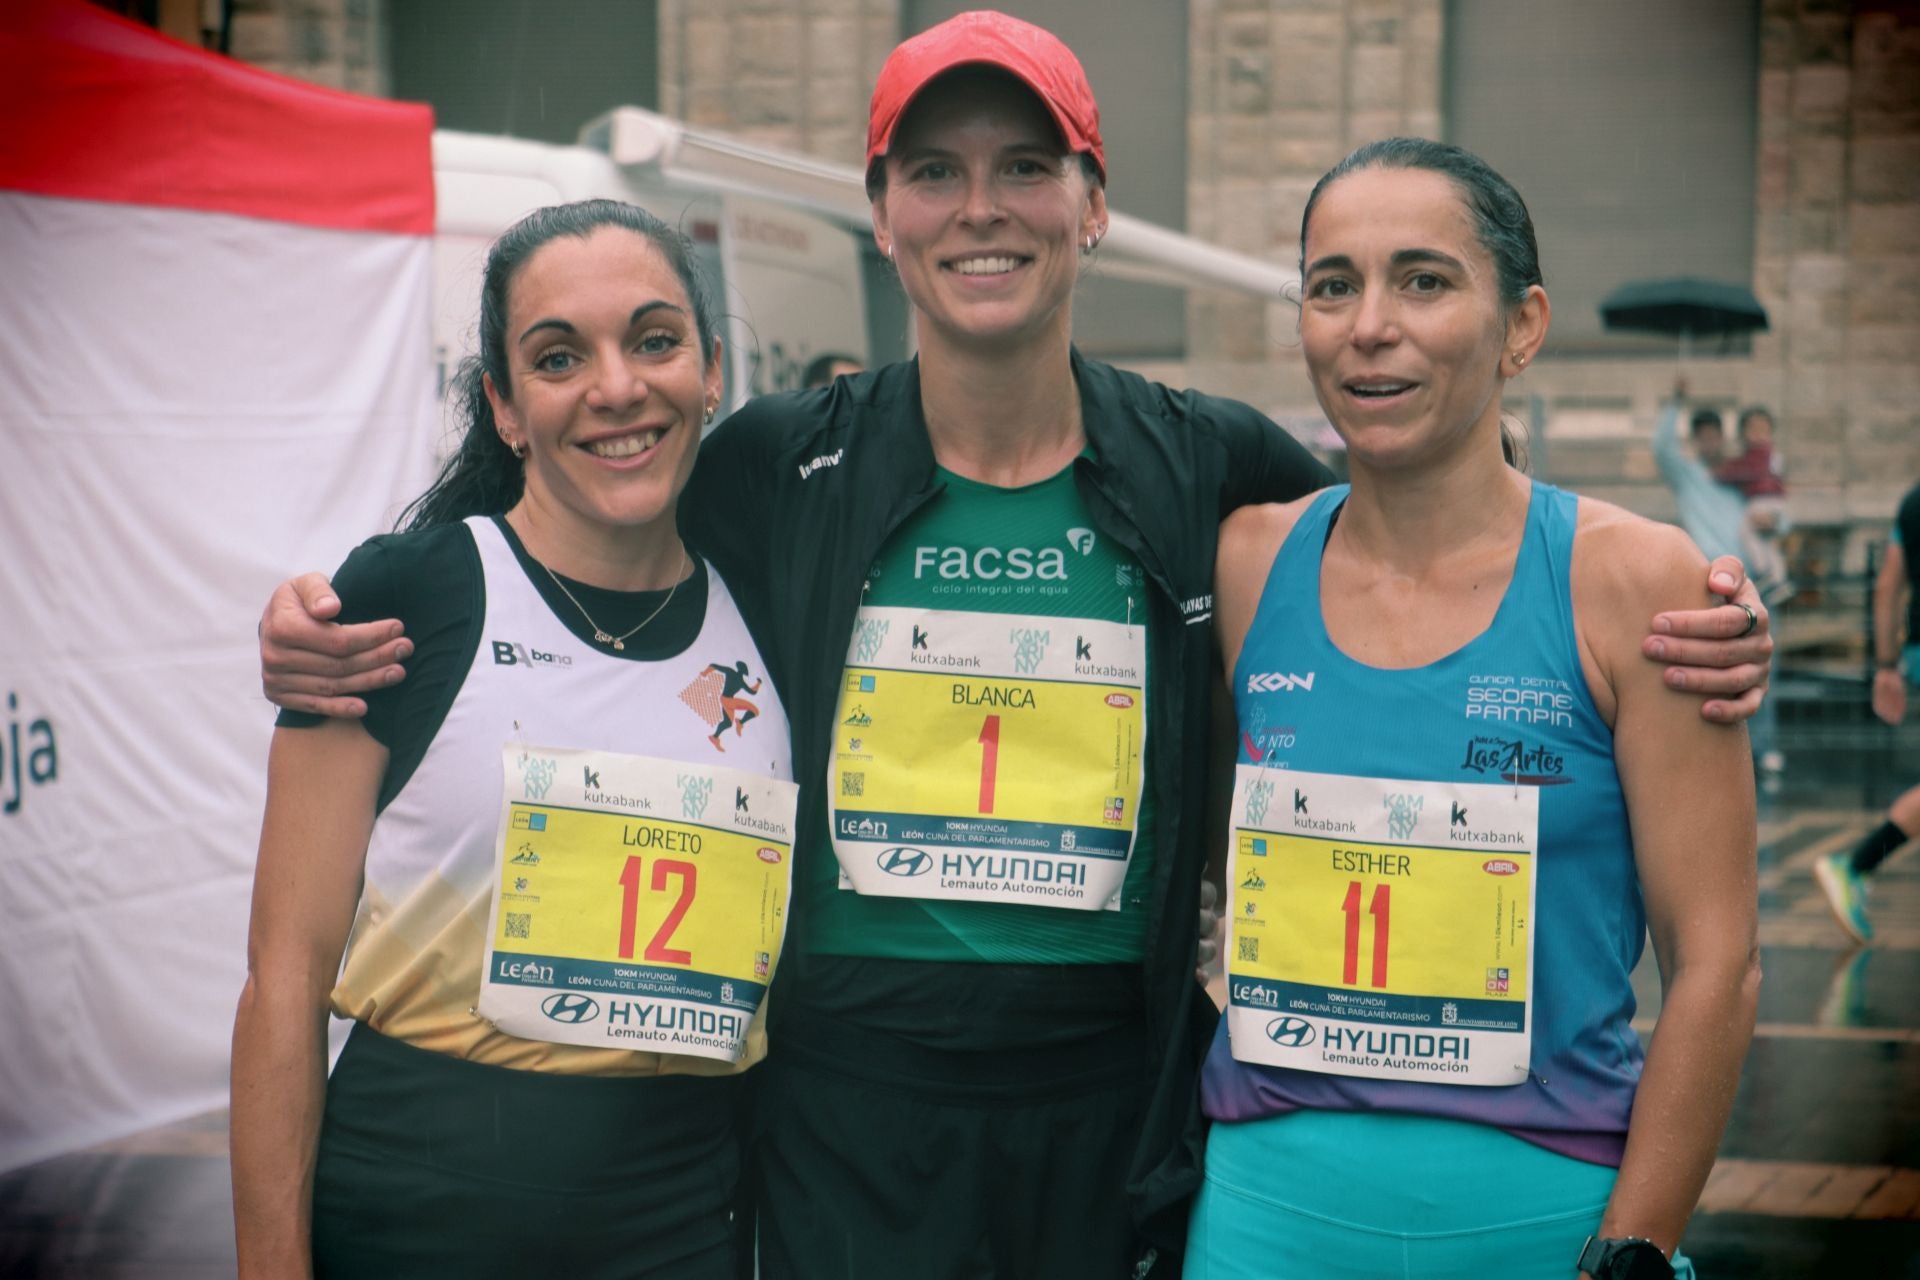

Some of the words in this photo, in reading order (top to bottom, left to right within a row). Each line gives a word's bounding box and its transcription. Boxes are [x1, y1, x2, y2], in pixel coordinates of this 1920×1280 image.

[932, 585, 961, 594] ciclo
[966, 585, 1011, 595] integral
[1017, 585, 1035, 594] del
[1040, 586, 1068, 595] agua
[1010, 628, 1050, 644] KAM
[531, 648, 572, 665] bana
[911, 651, 980, 668] kutxabank
[1074, 662, 1137, 679] kutxabank
[1521, 678, 1571, 691] DENTAL
[952, 684, 1036, 708] BLANCA
[1107, 695, 1132, 706] ABRIL
[1467, 688, 1572, 710] SEOANE
[1466, 704, 1572, 728] PAMPIN
[977, 715, 1000, 814] 1
[1461, 739, 1500, 774] Las
[1498, 740, 1564, 774] Artes
[677, 774, 713, 793] KAM
[584, 791, 652, 809] kutxabank
[1384, 793, 1424, 810] KAM
[734, 814, 786, 834] kutxabank
[946, 822, 969, 831] 10KM
[970, 824, 1007, 832] HYUNDAI
[1294, 816, 1356, 833] kutxabank
[623, 824, 702, 854] LORETO
[902, 830, 923, 839] LEÓN
[926, 832, 949, 840] CUNA
[969, 835, 1049, 848] PARLAMENTARISMO
[1450, 829, 1524, 844] kutxabank
[942, 853, 1085, 885] HYUNDAI
[1332, 850, 1410, 876] ESTHER
[1486, 862, 1516, 872] ABRIL
[940, 879, 998, 890] Lemauto
[1001, 881, 1084, 898] Automoción
[618, 855, 697, 965] 12
[1342, 881, 1390, 988] 11
[614, 969, 637, 978] 10KM
[639, 970, 677, 982] HYUNDAI
[568, 976, 591, 985] LEÓN
[593, 979, 617, 988] CUNA
[620, 982, 635, 990] DEL
[638, 983, 712, 999] PARLAMENTARISMO
[1328, 993, 1347, 1002] 10KM
[1349, 996, 1386, 1006] HYUNDAI
[609, 1001, 741, 1039] HYUNDAI
[1290, 1000, 1308, 1009] LEÓN
[1310, 1002, 1330, 1012] CUNA
[1332, 1006, 1346, 1014] DEL
[1348, 1008, 1430, 1022] PARLAMENTARISMO
[607, 1026, 667, 1042] Lemauto
[1324, 1026, 1470, 1060] HYUNDAI
[1322, 1051, 1379, 1066] Lemauto
[1382, 1058, 1468, 1073] Automoción
